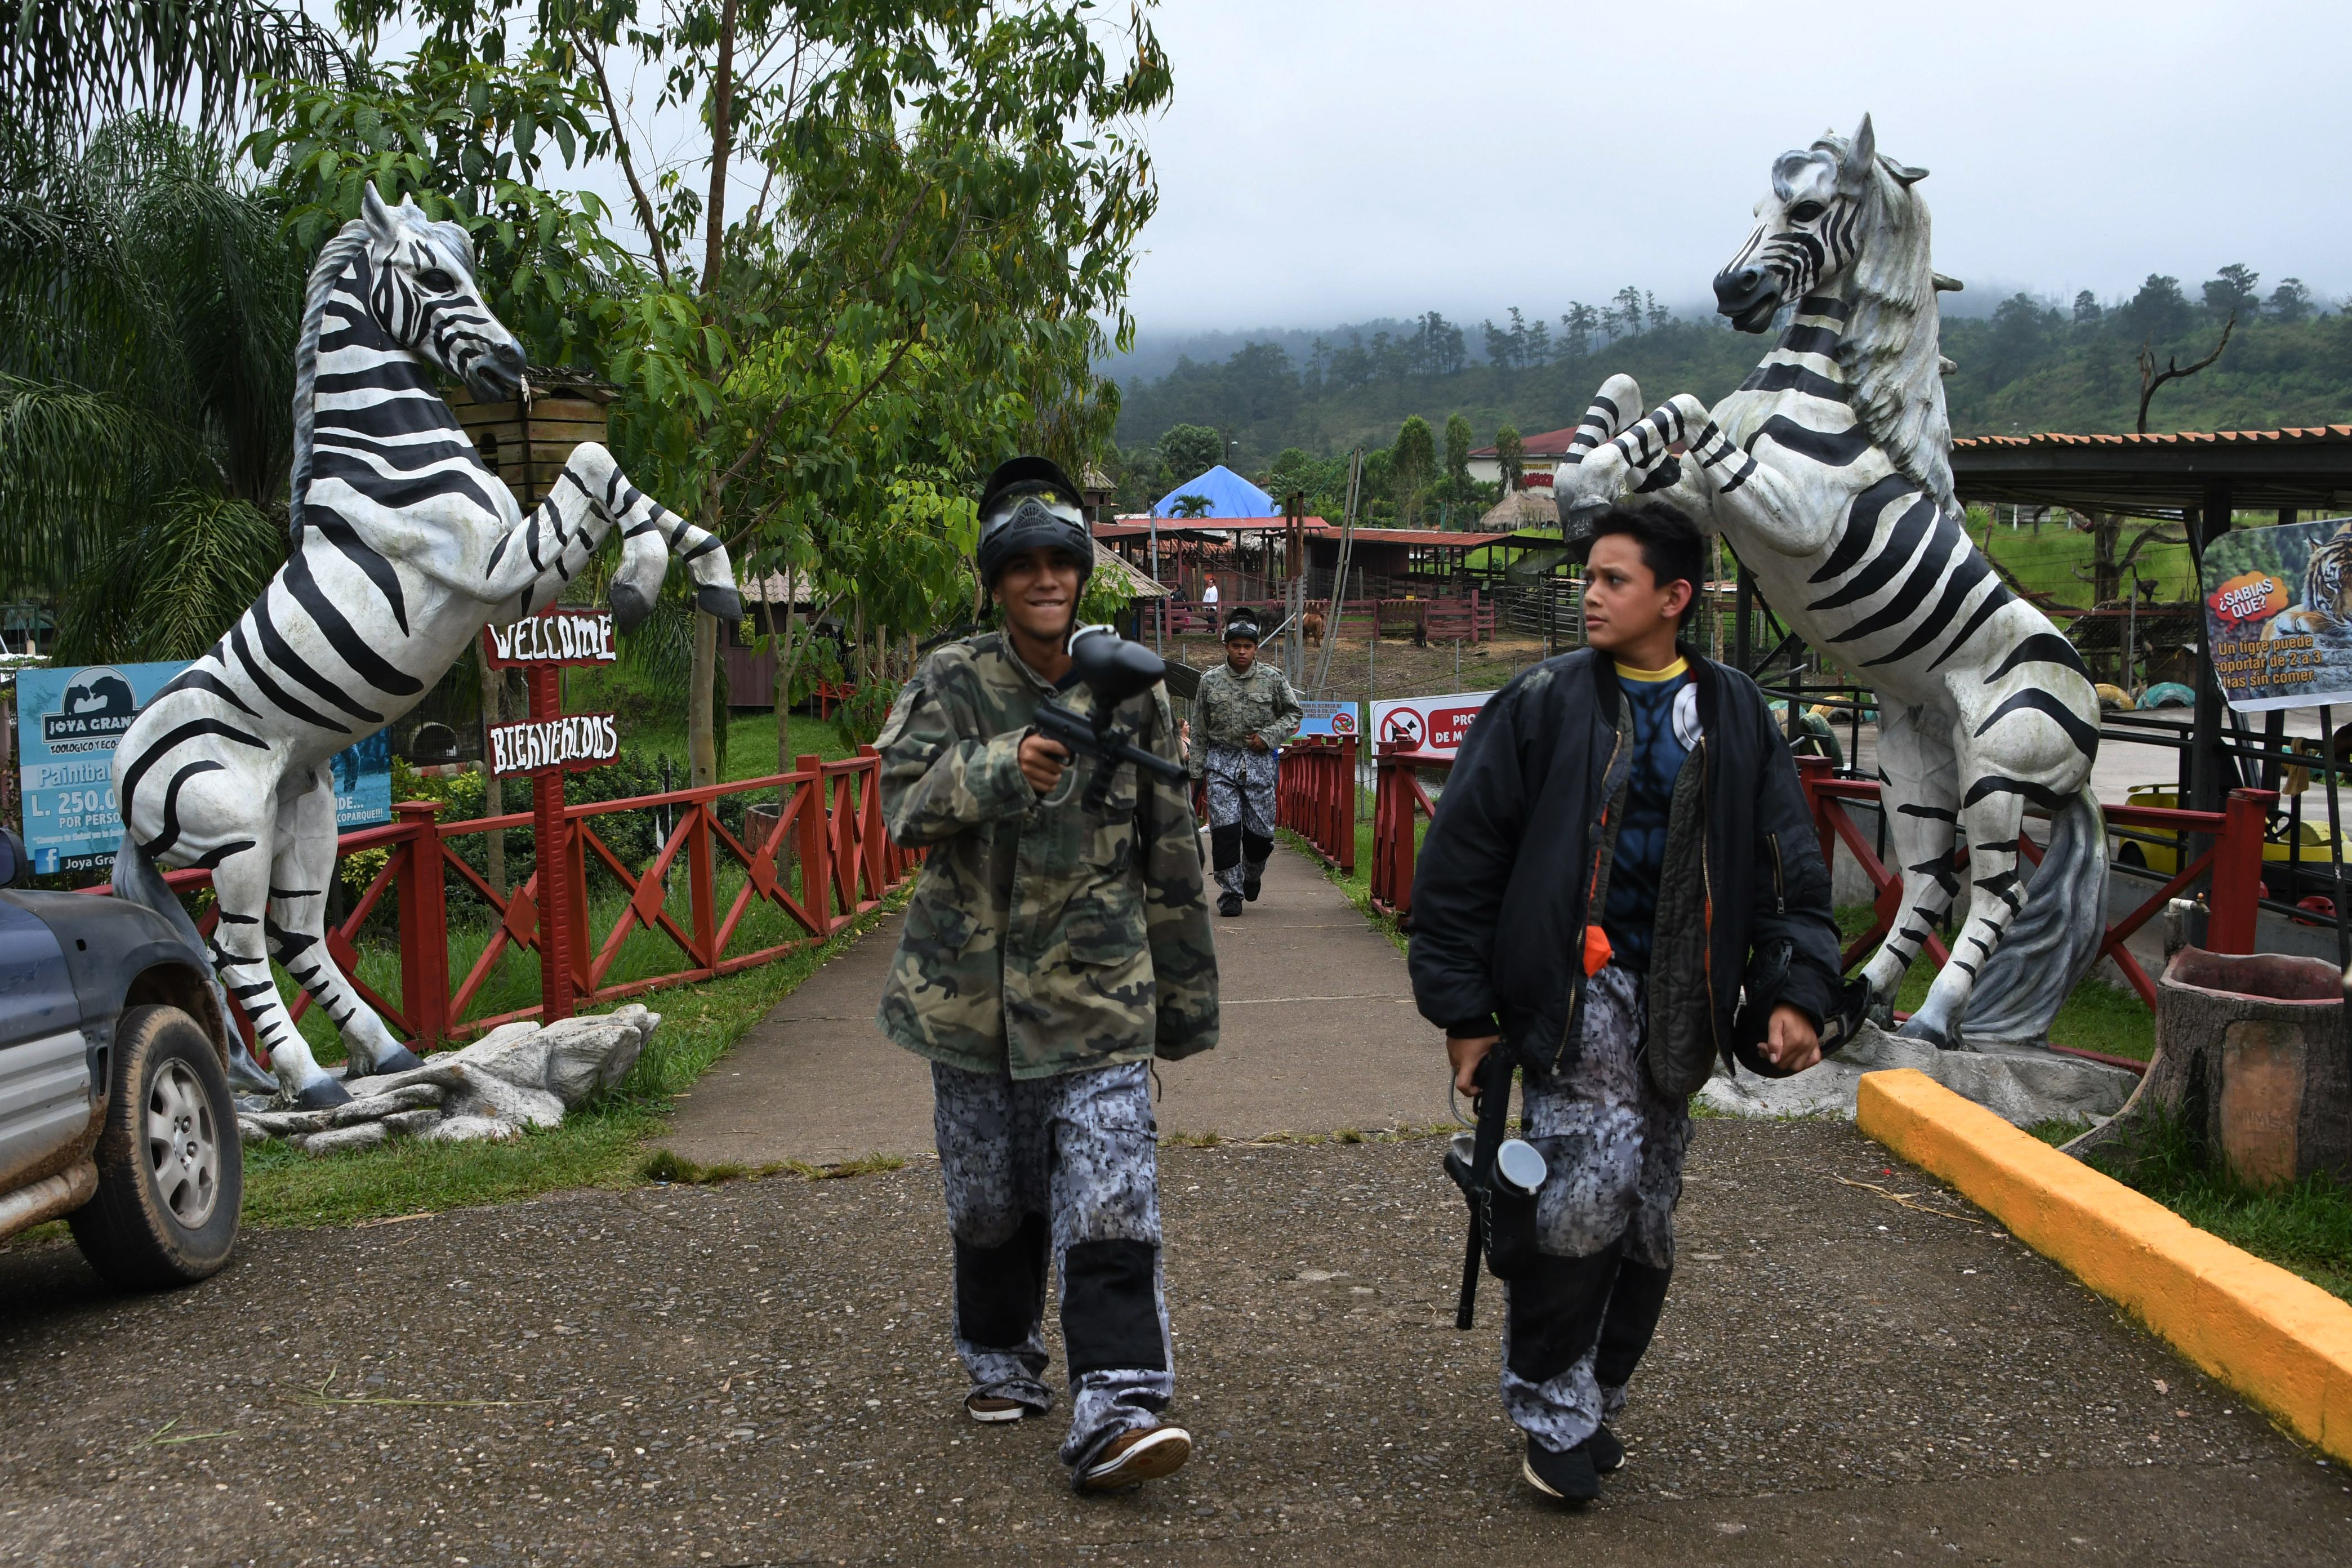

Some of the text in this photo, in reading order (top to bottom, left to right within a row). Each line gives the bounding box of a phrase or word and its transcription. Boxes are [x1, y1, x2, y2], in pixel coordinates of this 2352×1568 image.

[2220, 578, 2273, 611] ¿SABIAS
[2231, 595, 2266, 618] QUE?
[488, 614, 616, 660] WELCOME
[2218, 635, 2313, 656] Un tigre puede
[2213, 651, 2321, 674] soportar de 2 a 3
[2250, 672, 2269, 685] sin
[2273, 670, 2317, 684] comer.
[90, 715, 136, 730] GRAN
[1436, 730, 1467, 743] DE M
[51, 742, 93, 754] ZOOLOGICO
[32, 795, 51, 816] L.
[59, 812, 123, 829] POR PERSO
[65, 858, 92, 870] Joya
